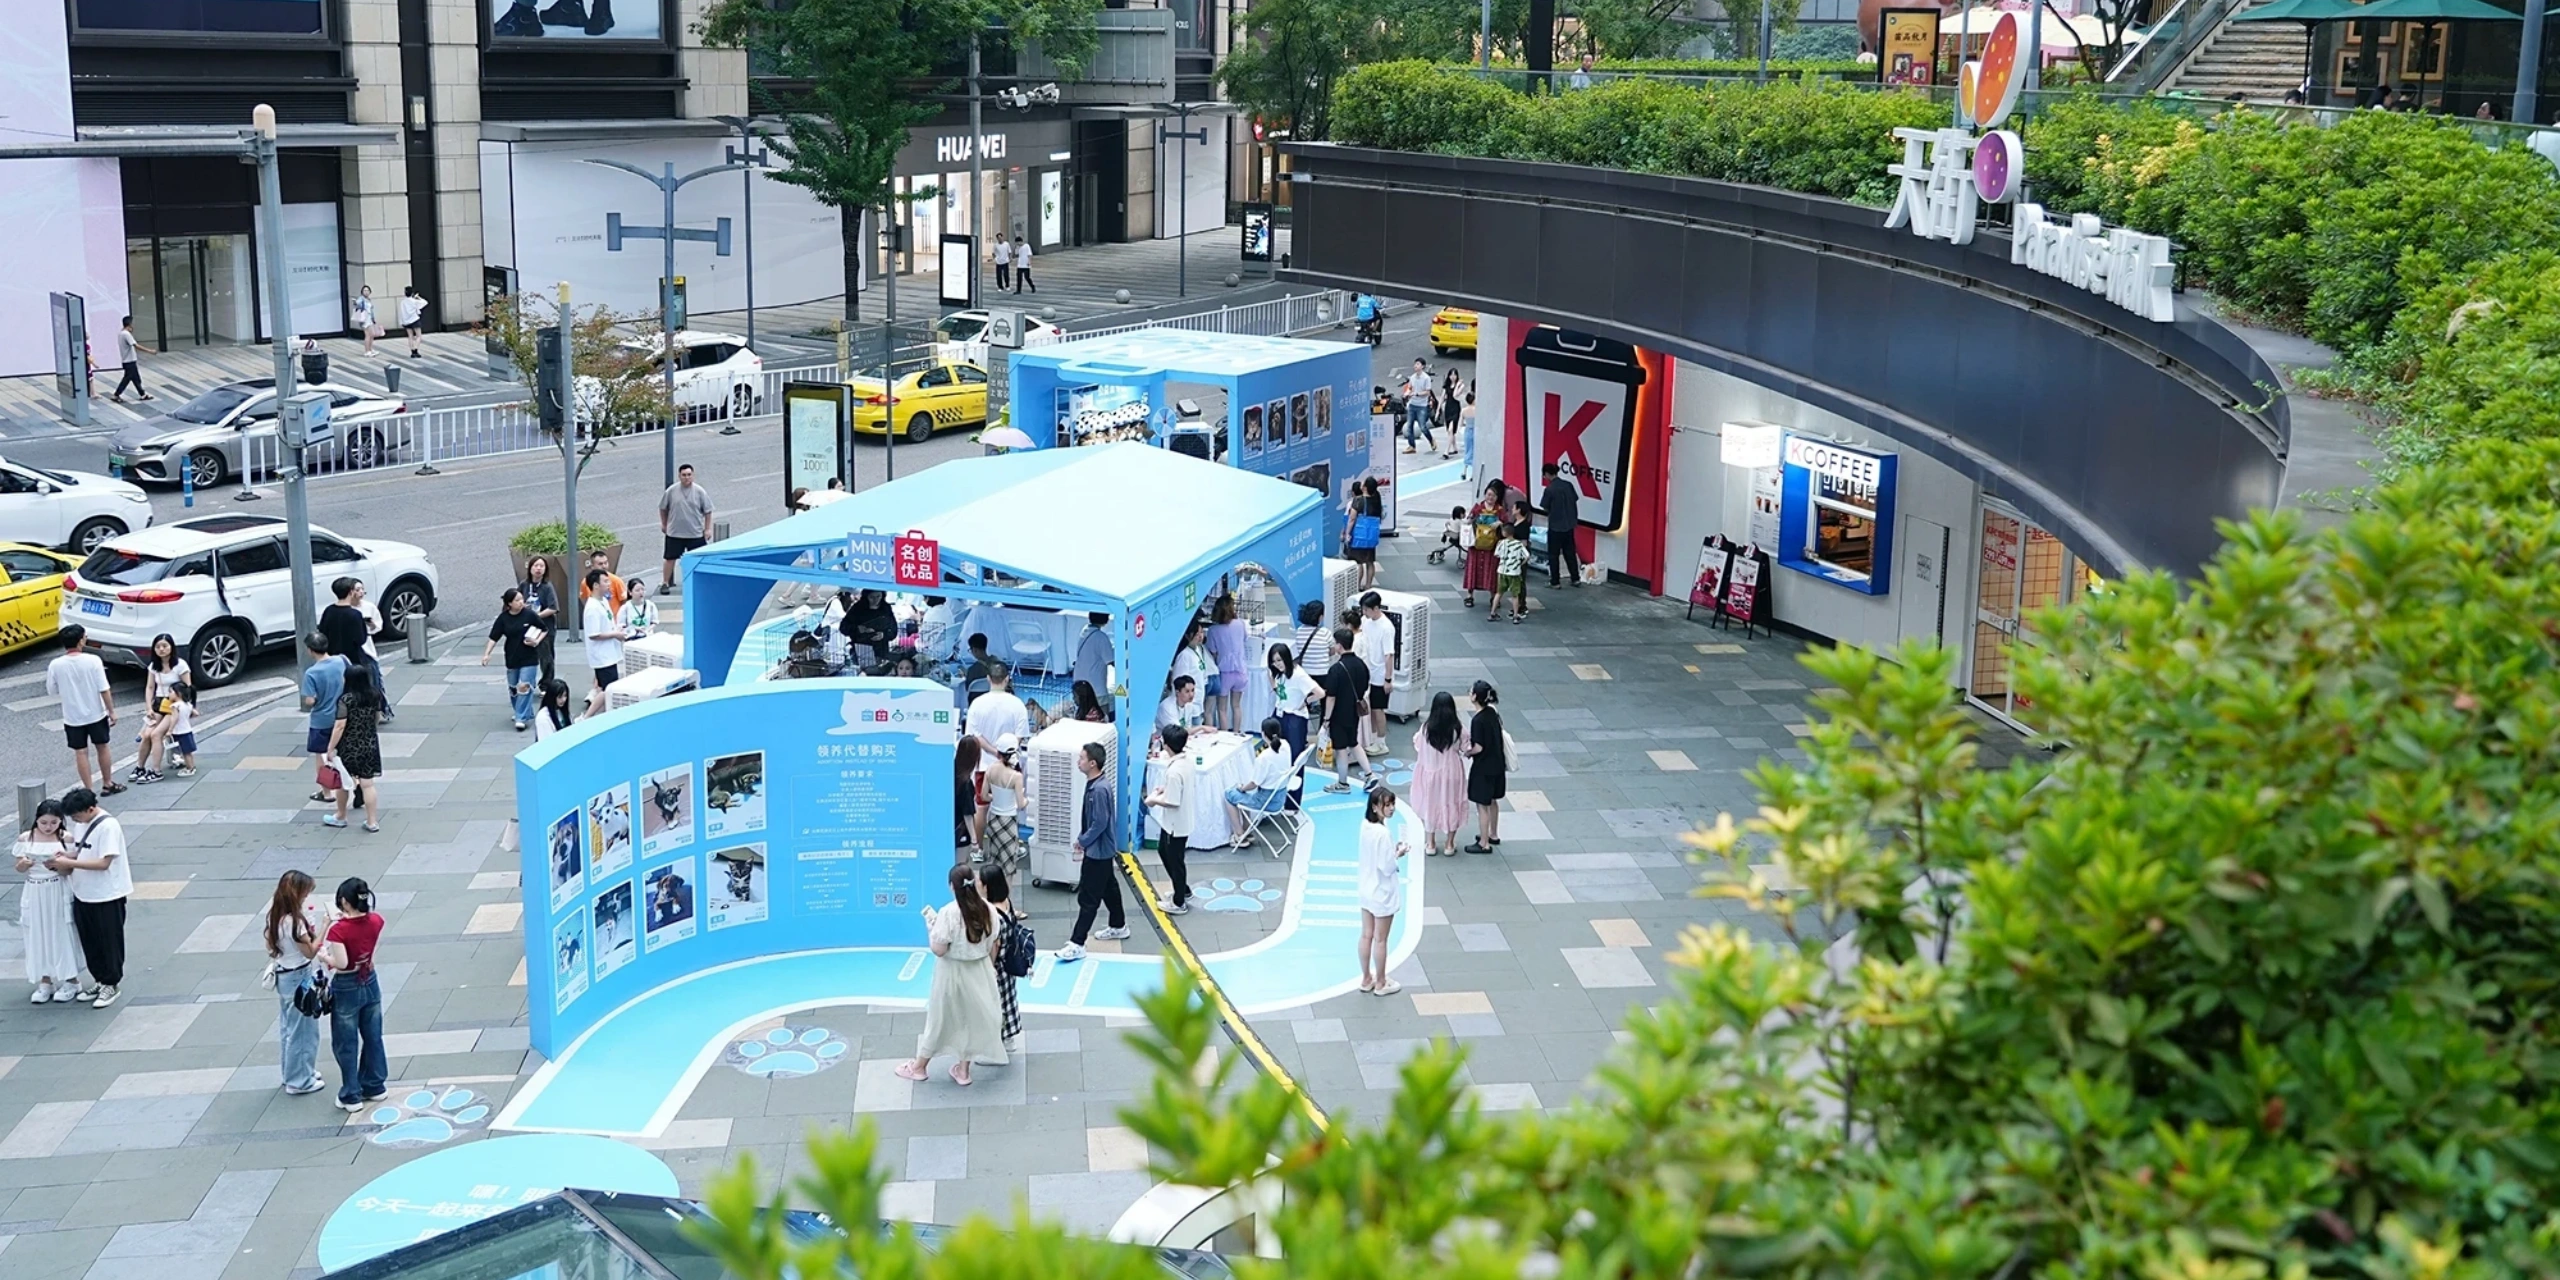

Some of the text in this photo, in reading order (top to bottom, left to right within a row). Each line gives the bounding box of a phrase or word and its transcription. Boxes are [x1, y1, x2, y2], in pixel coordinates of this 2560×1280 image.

[937, 134, 1007, 162] HUAWEI
[1542, 391, 1608, 501] K
[1560, 461, 1611, 485] COFFEE
[851, 540, 887, 557] MINI
[900, 543, 933, 563] 名创
[900, 562, 933, 581] 优品
[816, 744, 897, 757] 领养代替购买
